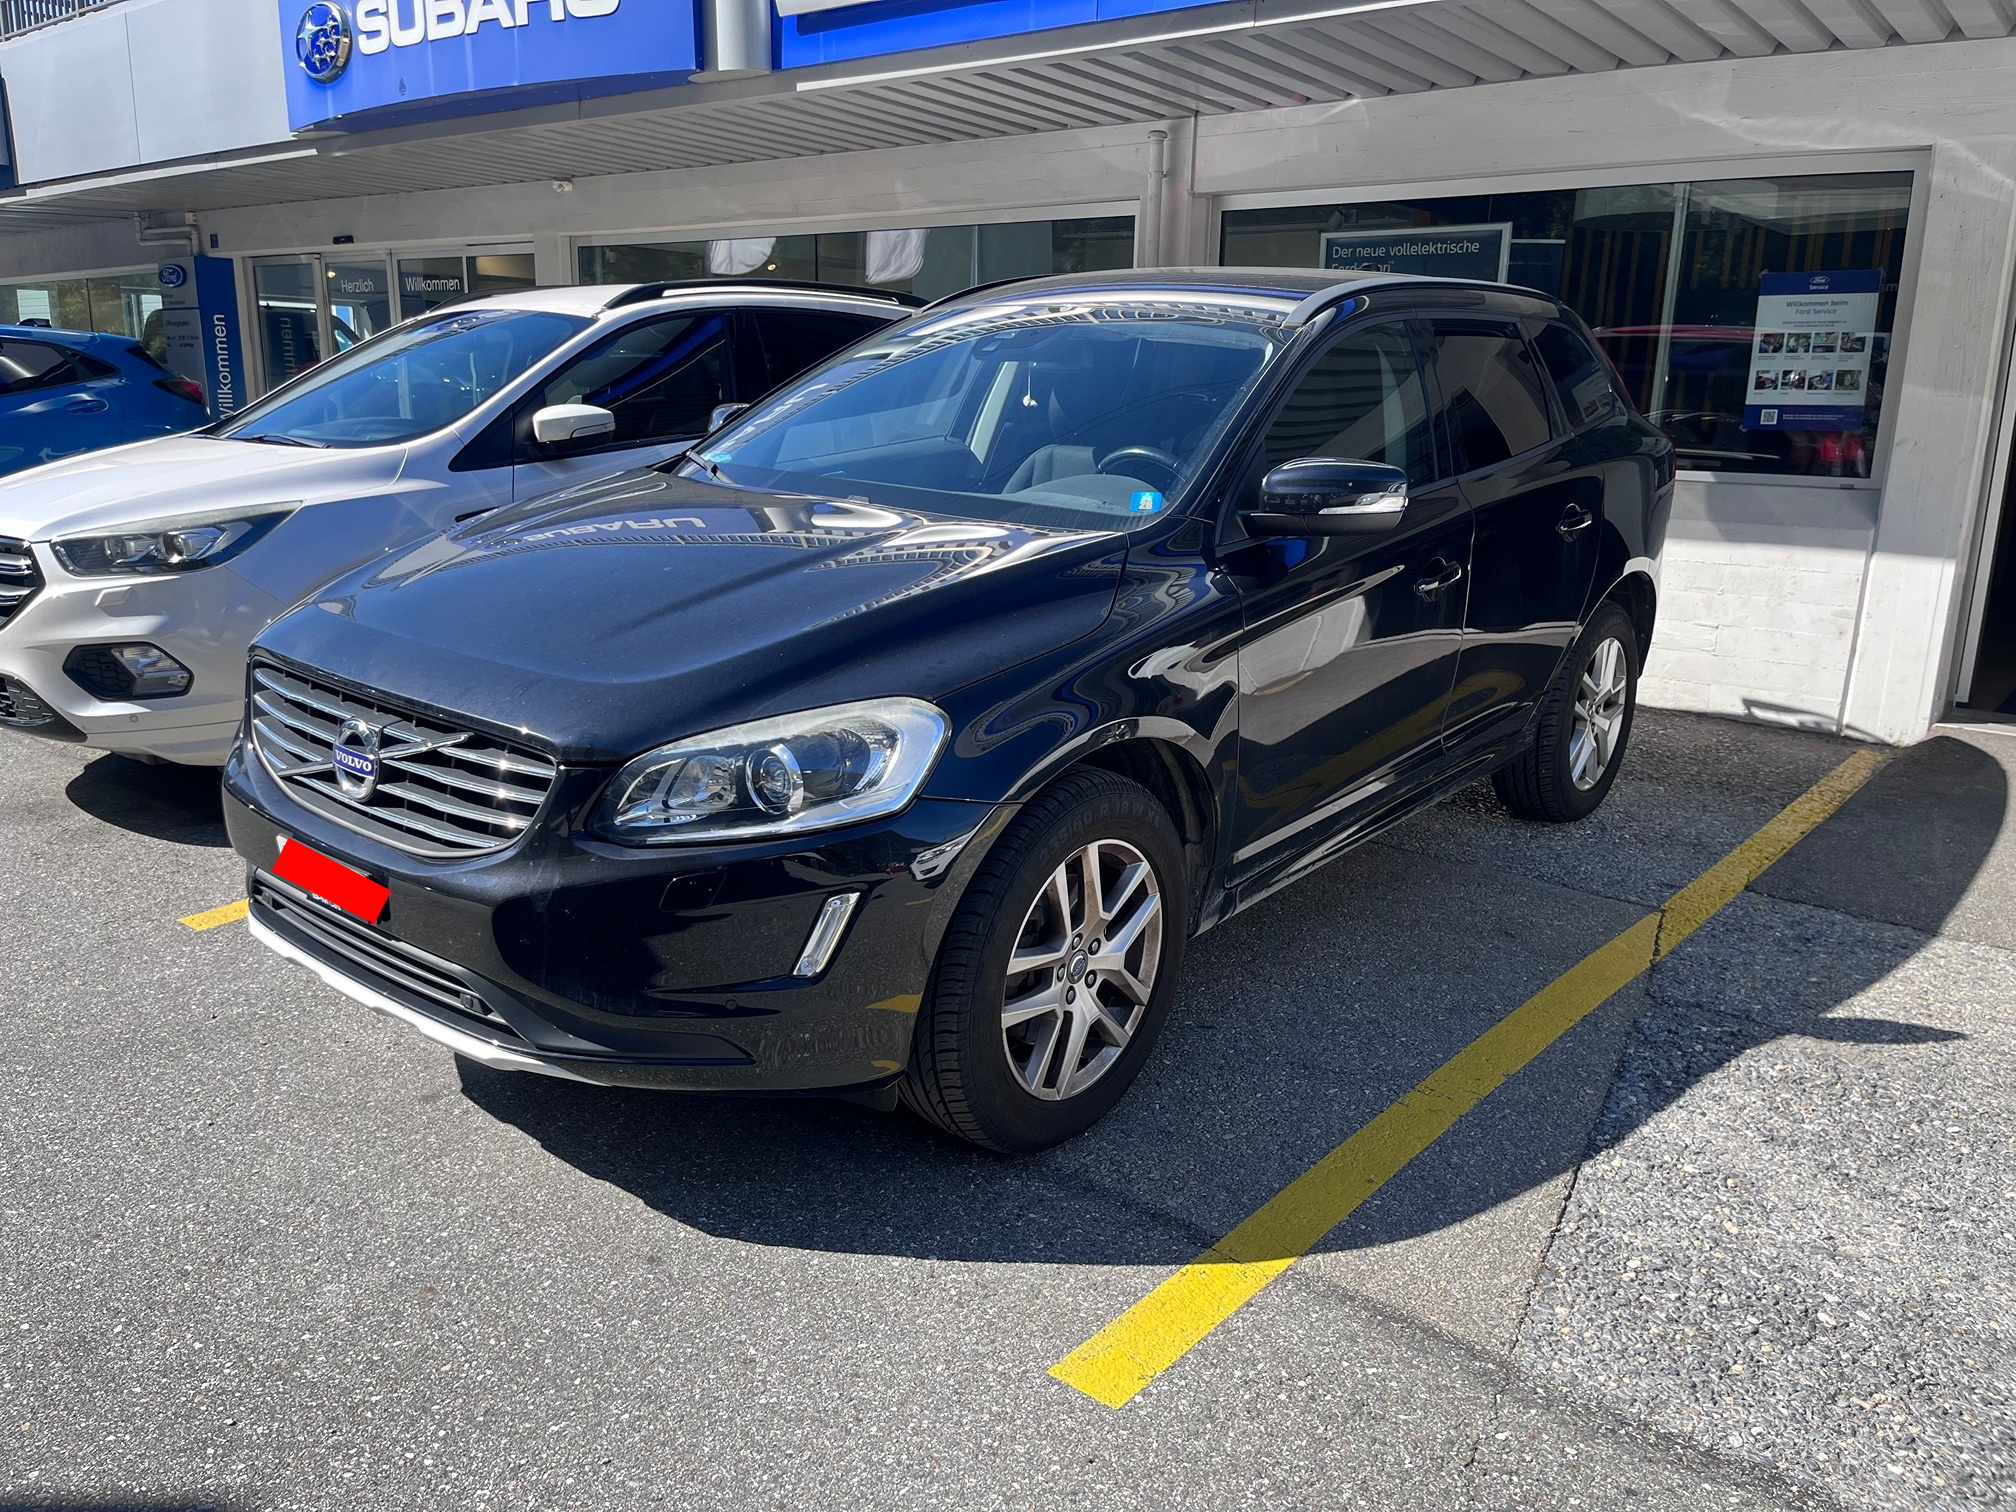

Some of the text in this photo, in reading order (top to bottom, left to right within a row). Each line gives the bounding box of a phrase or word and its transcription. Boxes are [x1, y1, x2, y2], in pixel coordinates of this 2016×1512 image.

[1332, 239, 1480, 258] Der neue vollelektrische
[341, 278, 374, 293] Herzlich
[405, 277, 460, 292] Willkommen
[1786, 300, 1830, 308] Willkommen
[1812, 307, 1837, 315] Service
[334, 749, 373, 772] VOLVO
